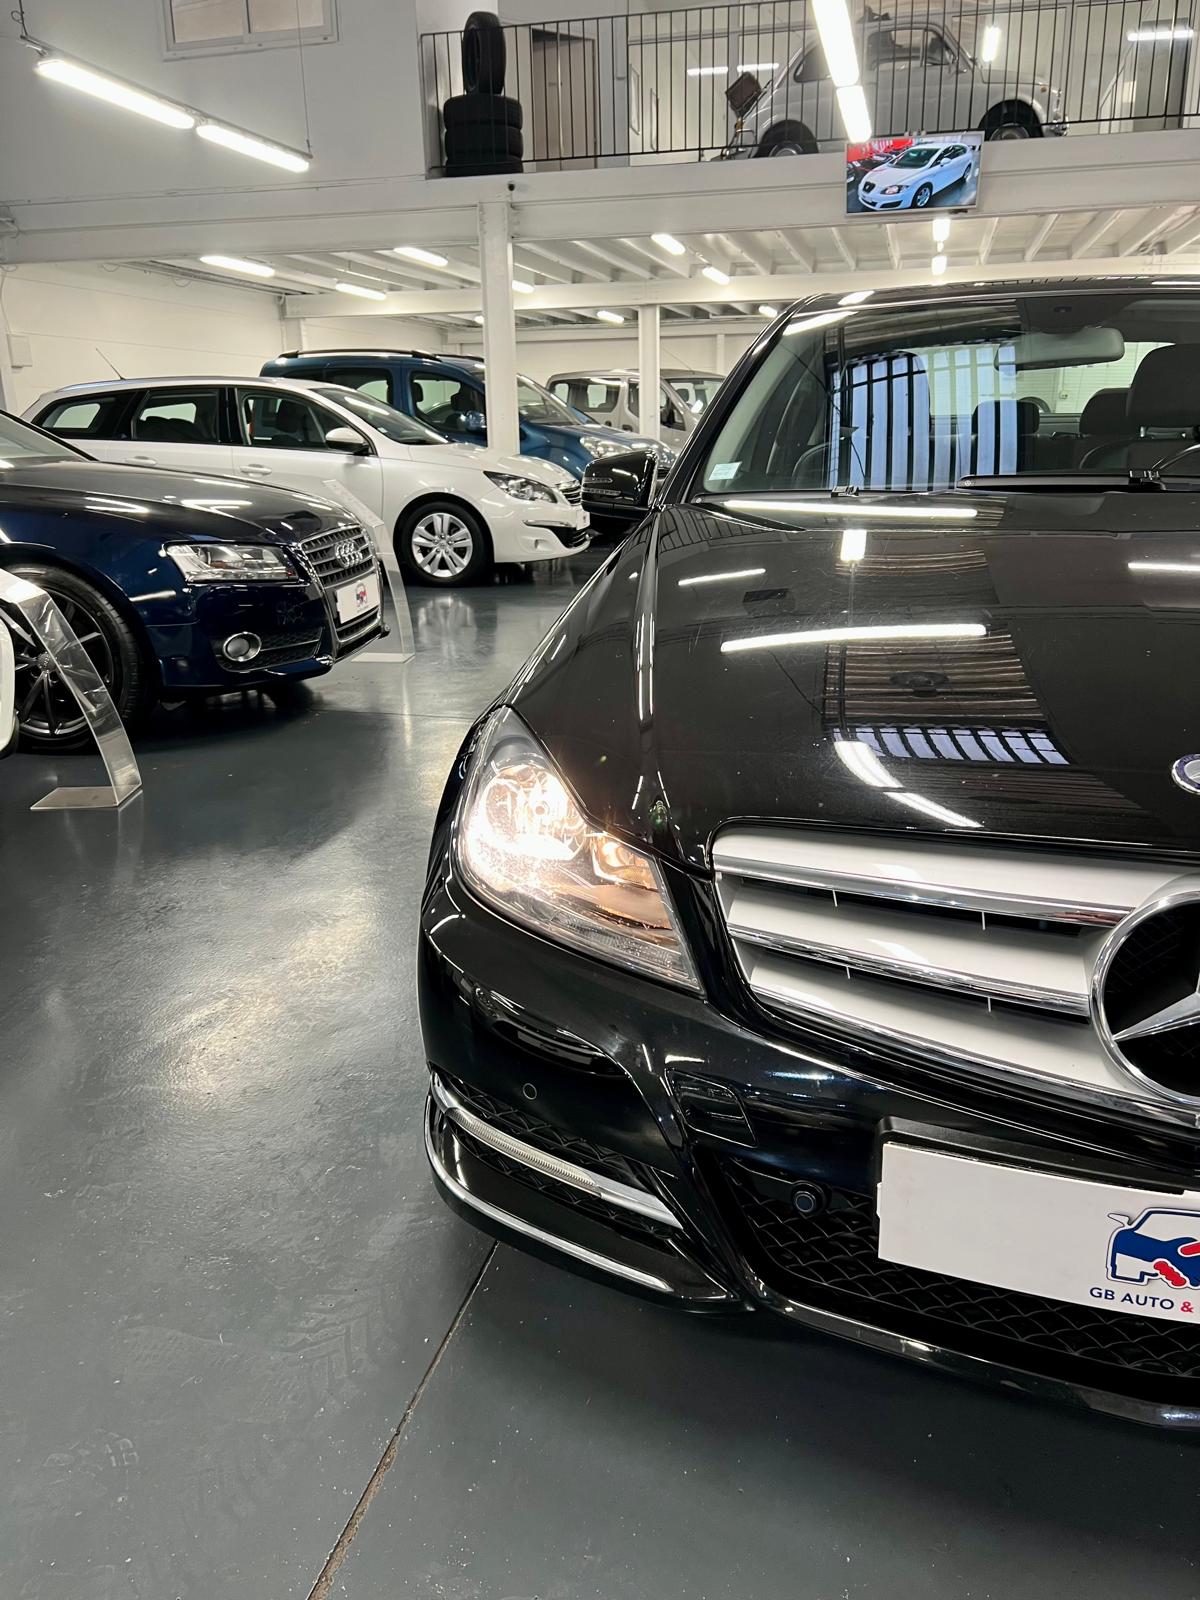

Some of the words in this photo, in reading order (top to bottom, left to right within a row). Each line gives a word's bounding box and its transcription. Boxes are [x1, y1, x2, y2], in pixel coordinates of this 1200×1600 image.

[1089, 1287, 1115, 1301] GB
[1120, 1292, 1175, 1310] AUTO
[1180, 1301, 1194, 1313] &
